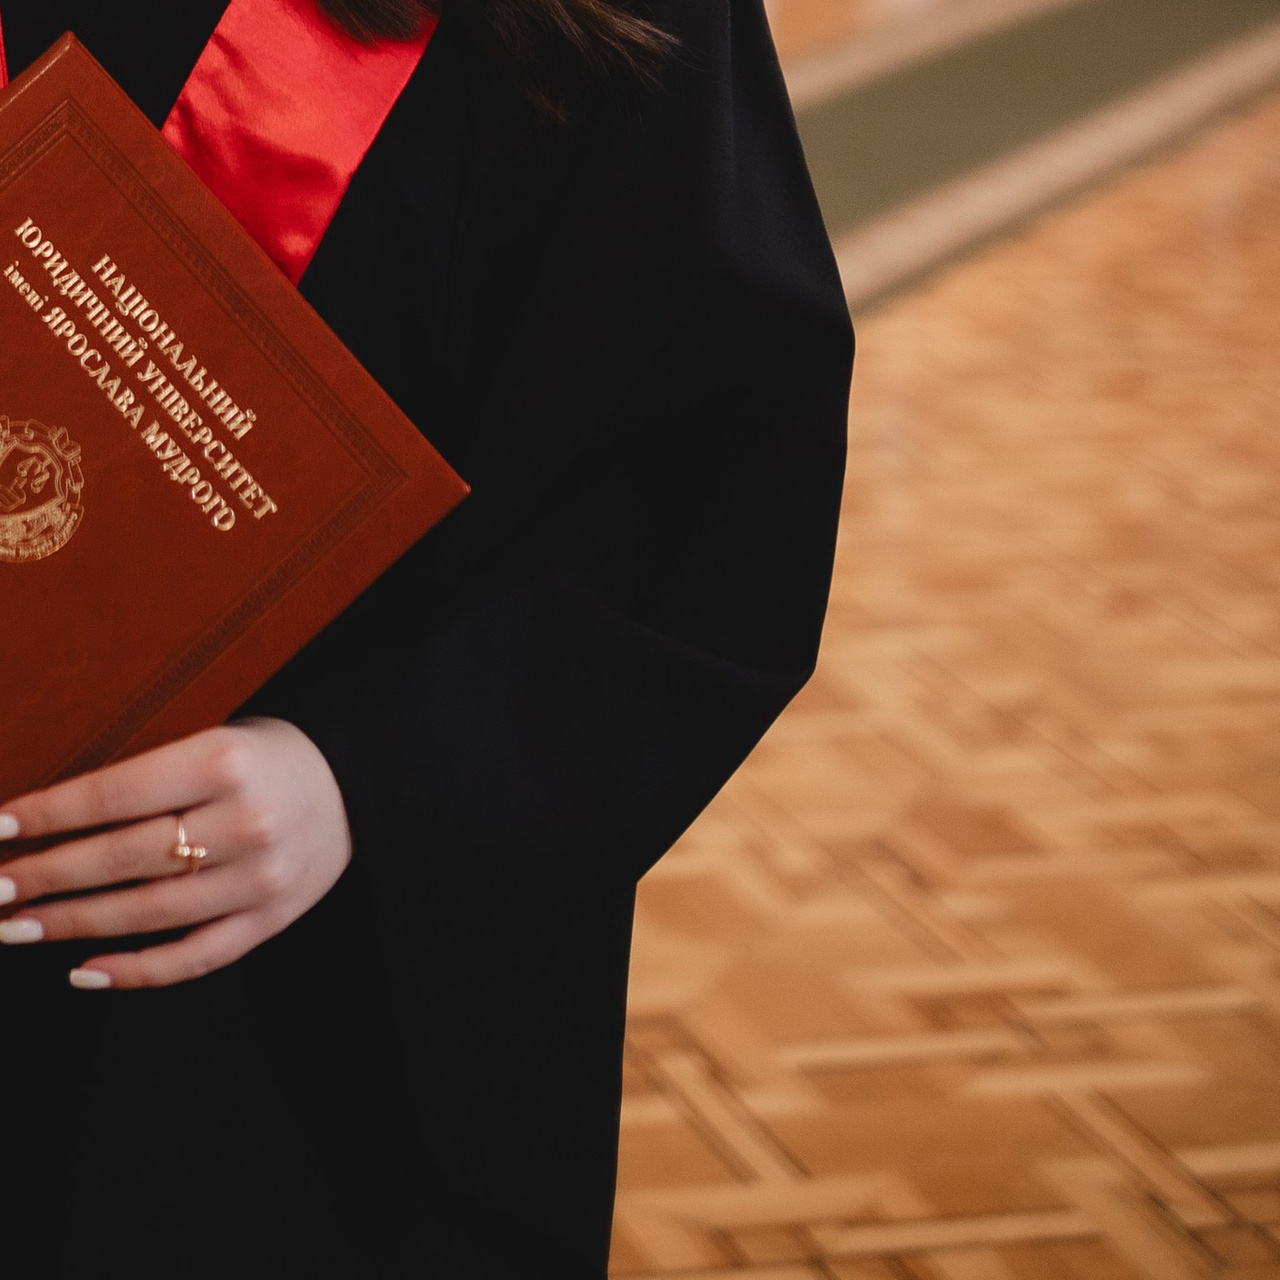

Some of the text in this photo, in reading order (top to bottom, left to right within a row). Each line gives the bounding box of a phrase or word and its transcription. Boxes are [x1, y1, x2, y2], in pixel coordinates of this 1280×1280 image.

[3, 260, 49, 312] імені
[42, 306, 146, 430] ЯРОСЛАВА
[140, 420, 236, 532] МУДРОГО
[14, 216, 149, 368] ЮРИДИЧНИЙ
[136, 359, 278, 520] УНІВЕРСИТЕТ
[91, 253, 257, 440] НАЦІОНАЛЬНИЙ
